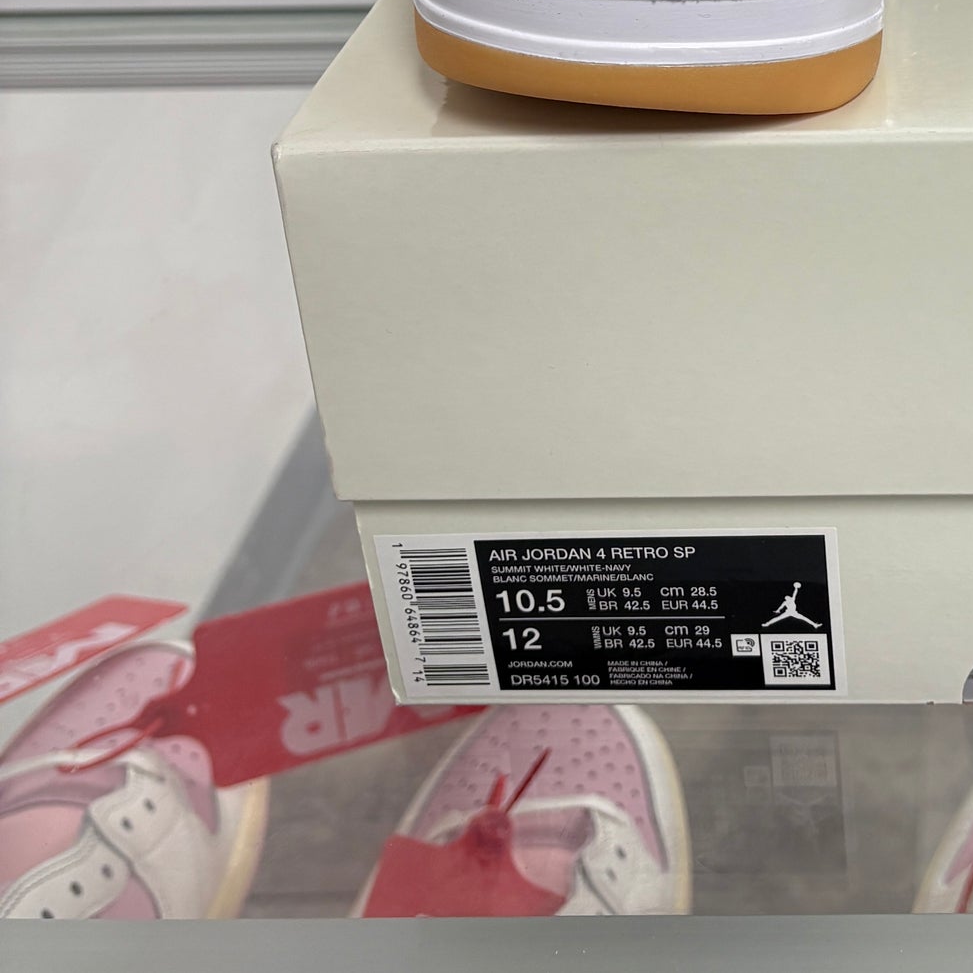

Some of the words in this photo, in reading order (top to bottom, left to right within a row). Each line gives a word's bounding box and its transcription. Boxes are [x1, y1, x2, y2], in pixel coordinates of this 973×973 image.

[489, 549, 518, 561] AIR
[521, 547, 592, 561] JORDAN
[596, 547, 607, 559] 4
[610, 546, 669, 559] RETRO
[673, 546, 696, 558] SP
[491, 565, 532, 574] SUMMIT
[534, 563, 632, 573] WHITE/WHITE-NAVY
[395, 562, 414, 600] 97860
[492, 574, 528, 583] BLANC
[529, 573, 654, 583] SOMMET/MARINE/BLANC
[597, 587, 617, 597] UK
[622, 587, 642, 597] 9.5
[690, 586, 718, 597] 28.5
[495, 589, 566, 613] 10.5
[586, 588, 596, 610] MENS
[599, 600, 619, 611] BR
[623, 600, 651, 611] 42.5
[661, 600, 689, 610] EUR
[691, 600, 719, 610] 44.5
[404, 607, 422, 643] 64864
[602, 625, 622, 636] UK
[627, 625, 647, 636] 9.5
[694, 625, 710, 635] 29
[502, 627, 543, 650] 12
[604, 638, 624, 649] BR
[629, 638, 656, 649] 42.5
[666, 638, 693, 648] EUR
[695, 638, 723, 648] 44.5
[507, 660, 573, 668] JORDAN.COM
[412, 670, 425, 682] 14
[510, 674, 570, 686] DR5415
[573, 674, 601, 685] 100
